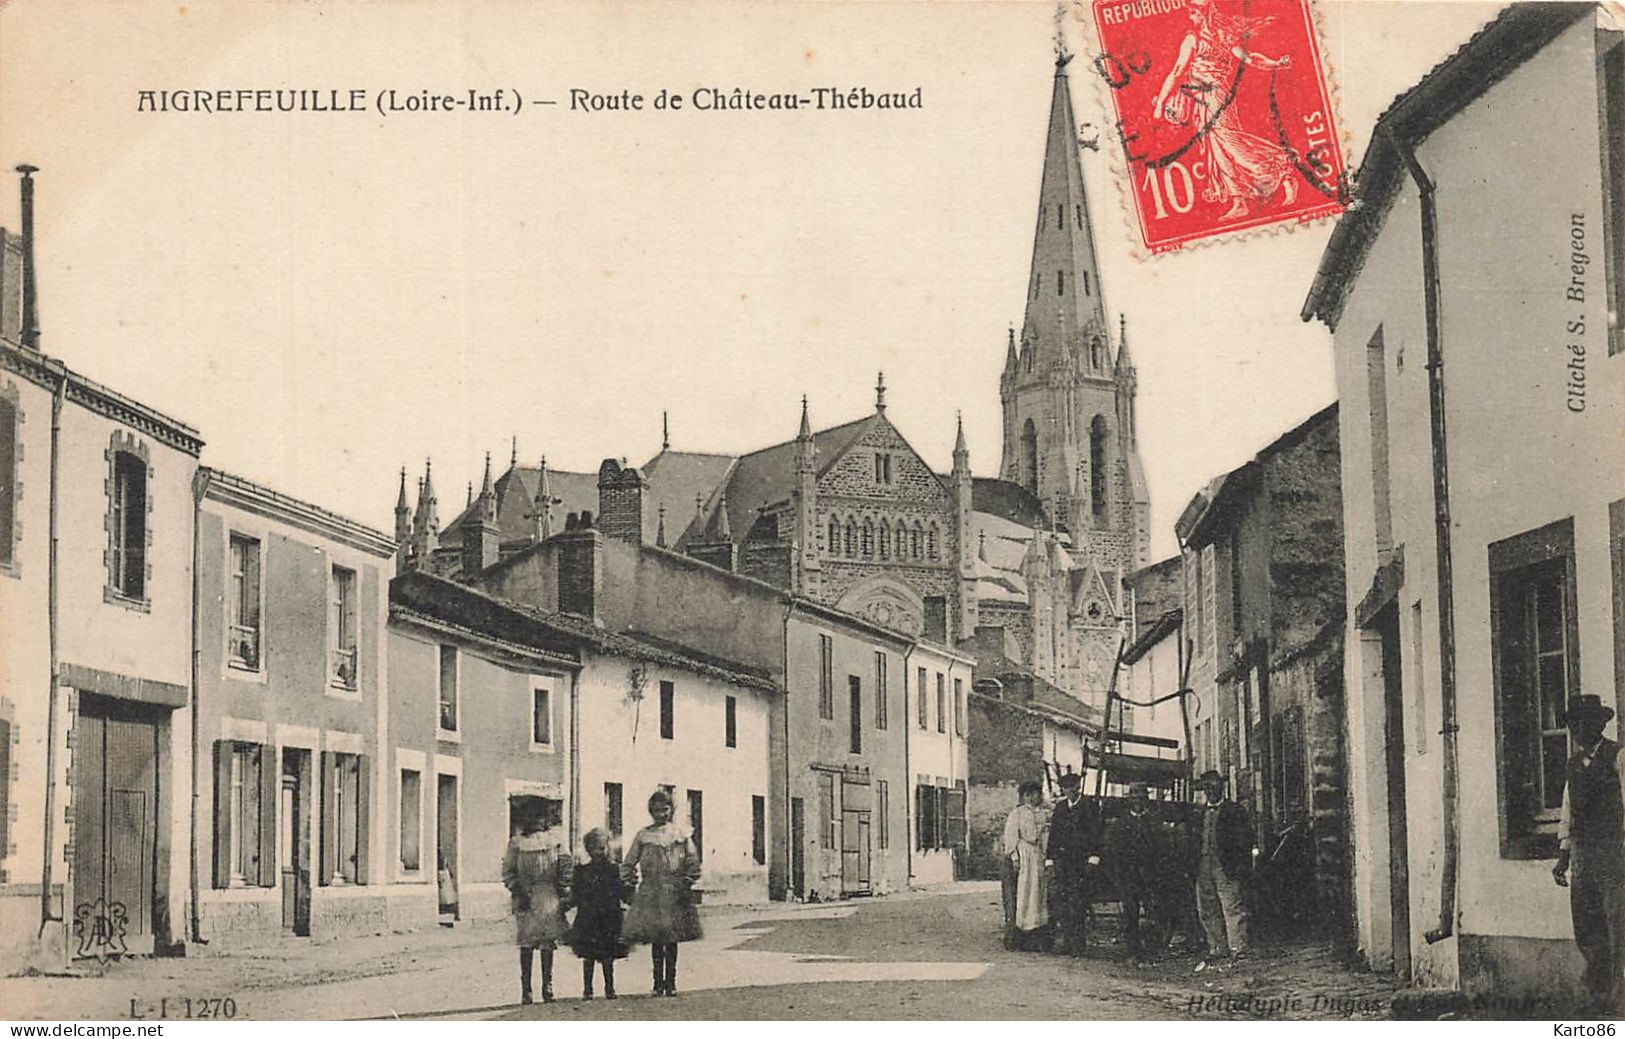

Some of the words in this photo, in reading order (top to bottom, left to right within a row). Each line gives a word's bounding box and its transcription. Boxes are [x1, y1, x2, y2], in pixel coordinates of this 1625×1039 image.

[1103, 0, 1187, 25] REPUBLIQU
[137, 90, 367, 114] AIGREFEUILLE
[376, 89, 522, 117] (Loire-Inf.)
[570, 88, 644, 113] Route
[653, 89, 683, 111] de
[692, 87, 923, 111] Château-Thébaud
[1304, 110, 1337, 191] POSTES
[1567, 213, 1590, 303] Bregeon
[1567, 315, 1586, 335] S.
[1567, 344, 1586, 413] Cliché
[185, 998, 237, 1018] 1270
